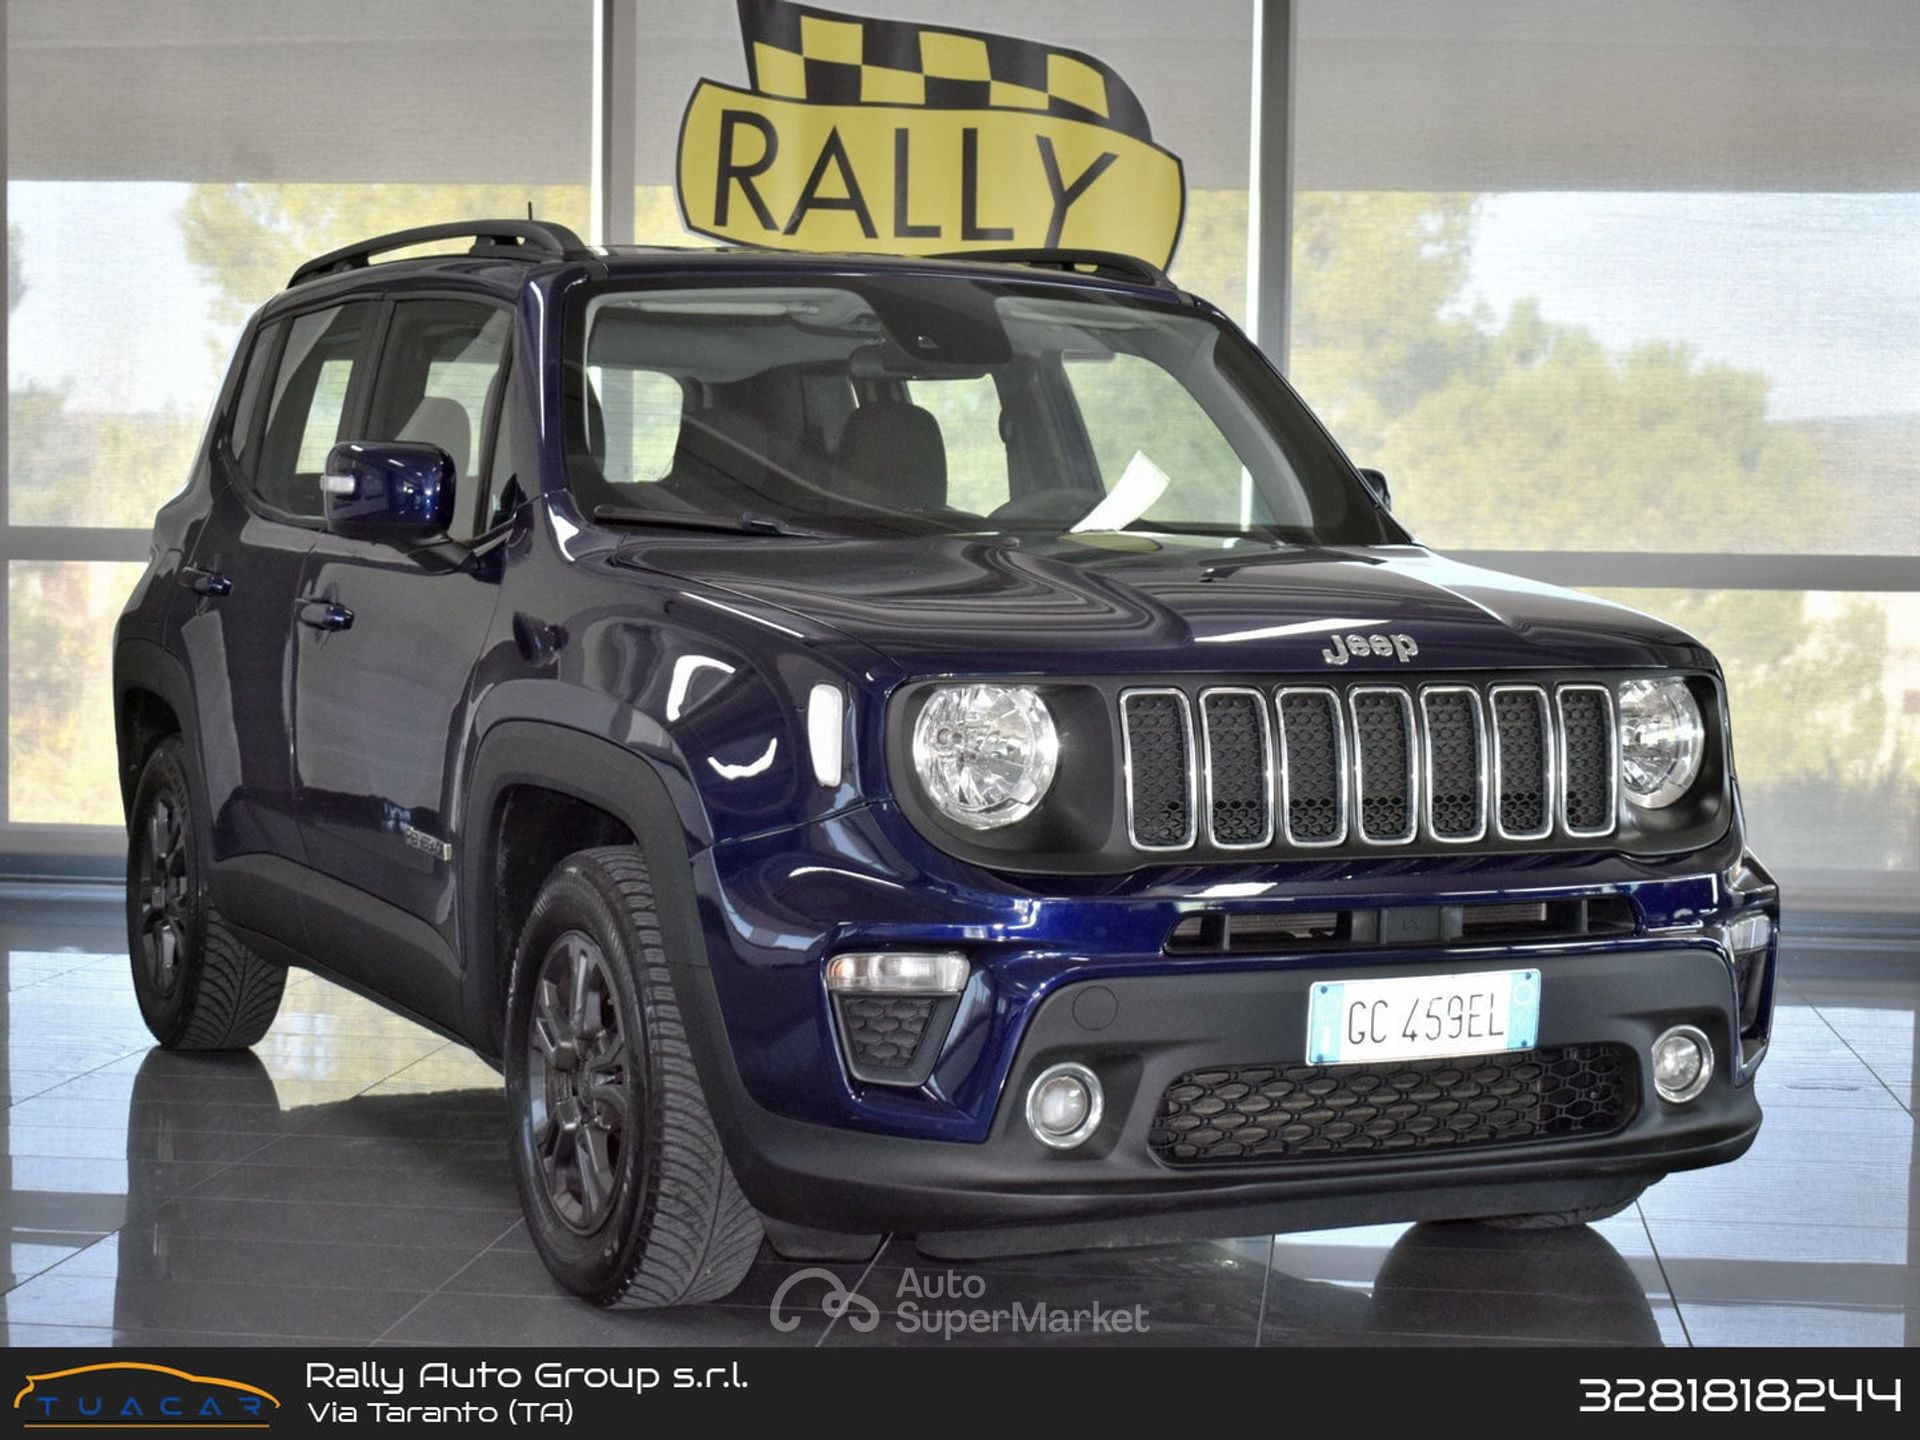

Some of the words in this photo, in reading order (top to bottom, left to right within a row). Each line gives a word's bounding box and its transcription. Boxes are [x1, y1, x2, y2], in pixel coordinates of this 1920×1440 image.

[714, 109, 1119, 249] RALLY
[1322, 634, 1418, 665] Jeep
[1348, 1000, 1388, 1045] GC
[1402, 993, 1504, 1042] 459EL
